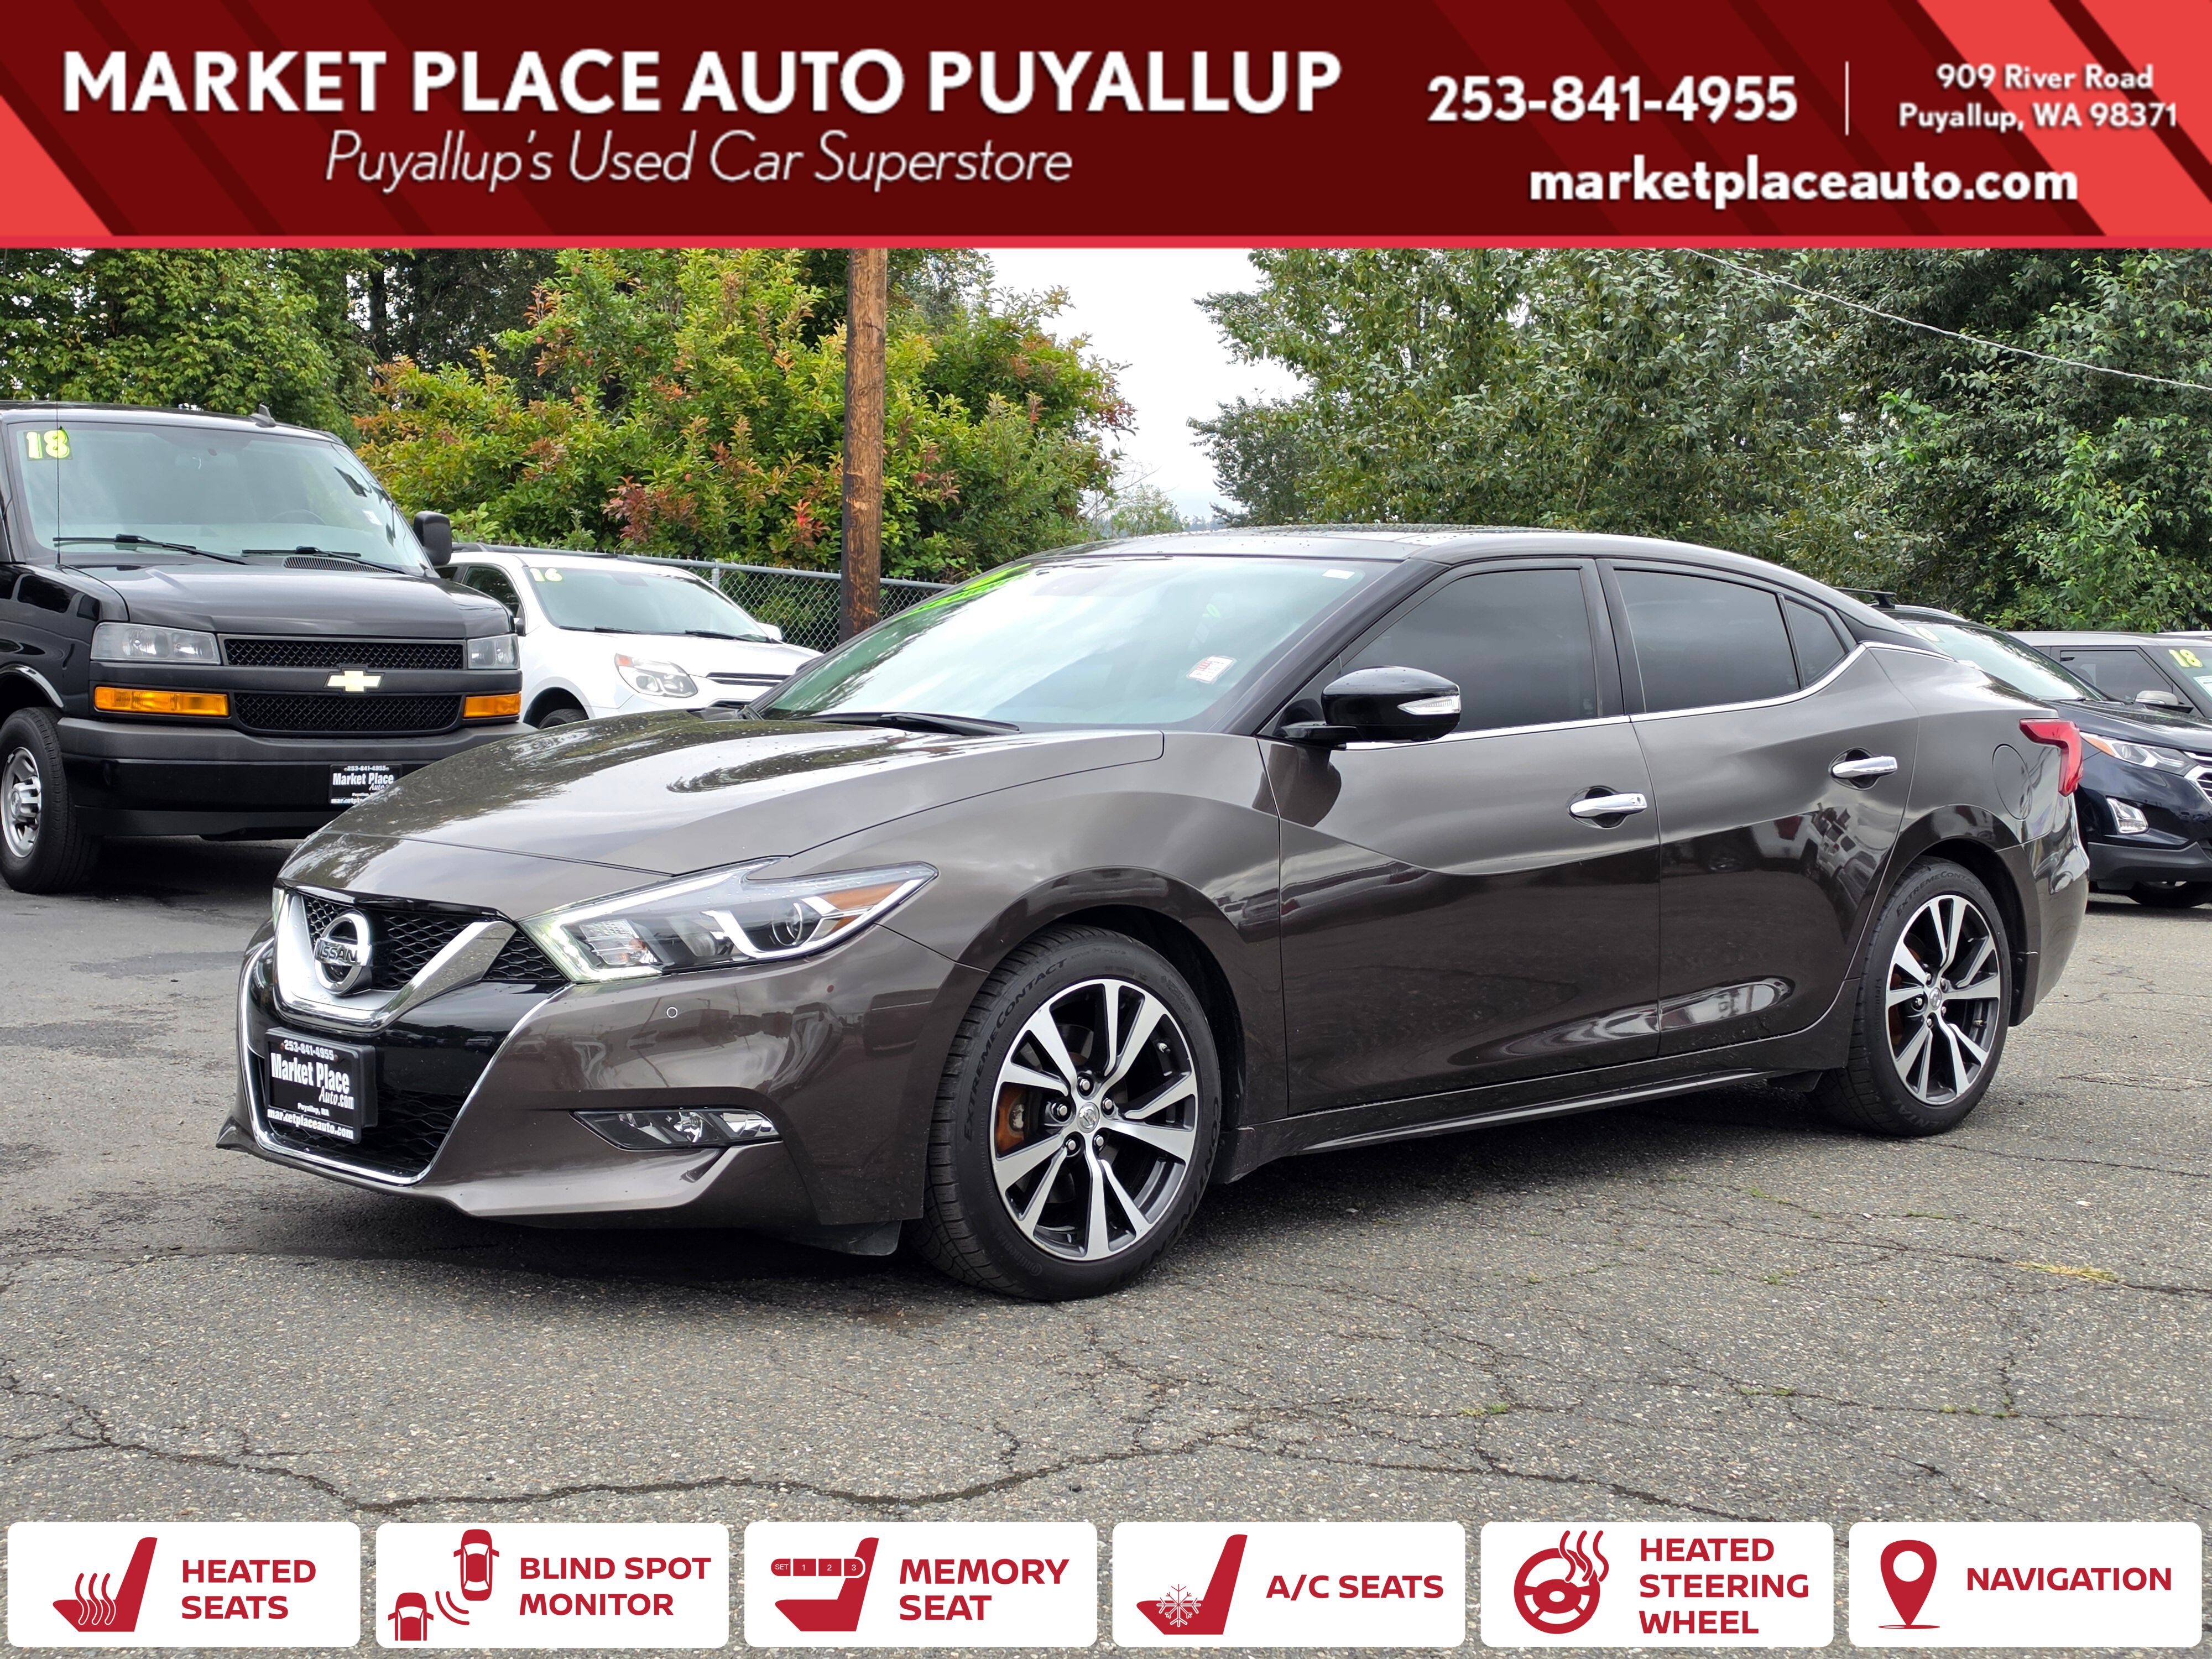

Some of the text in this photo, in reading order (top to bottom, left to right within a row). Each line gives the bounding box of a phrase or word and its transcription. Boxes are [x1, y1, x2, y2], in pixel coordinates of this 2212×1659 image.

[26, 430, 70, 459] 18
[530, 567, 563, 582] 16
[2168, 649, 2203, 667] 18
[332, 772, 394, 785] Market Place
[284, 1039, 335, 1061] 253-841-4955
[270, 1052, 350, 1094] Market Place
[319, 1085, 354, 1110] Auto.com
[267, 1108, 354, 1140] marketplaceauto.com
